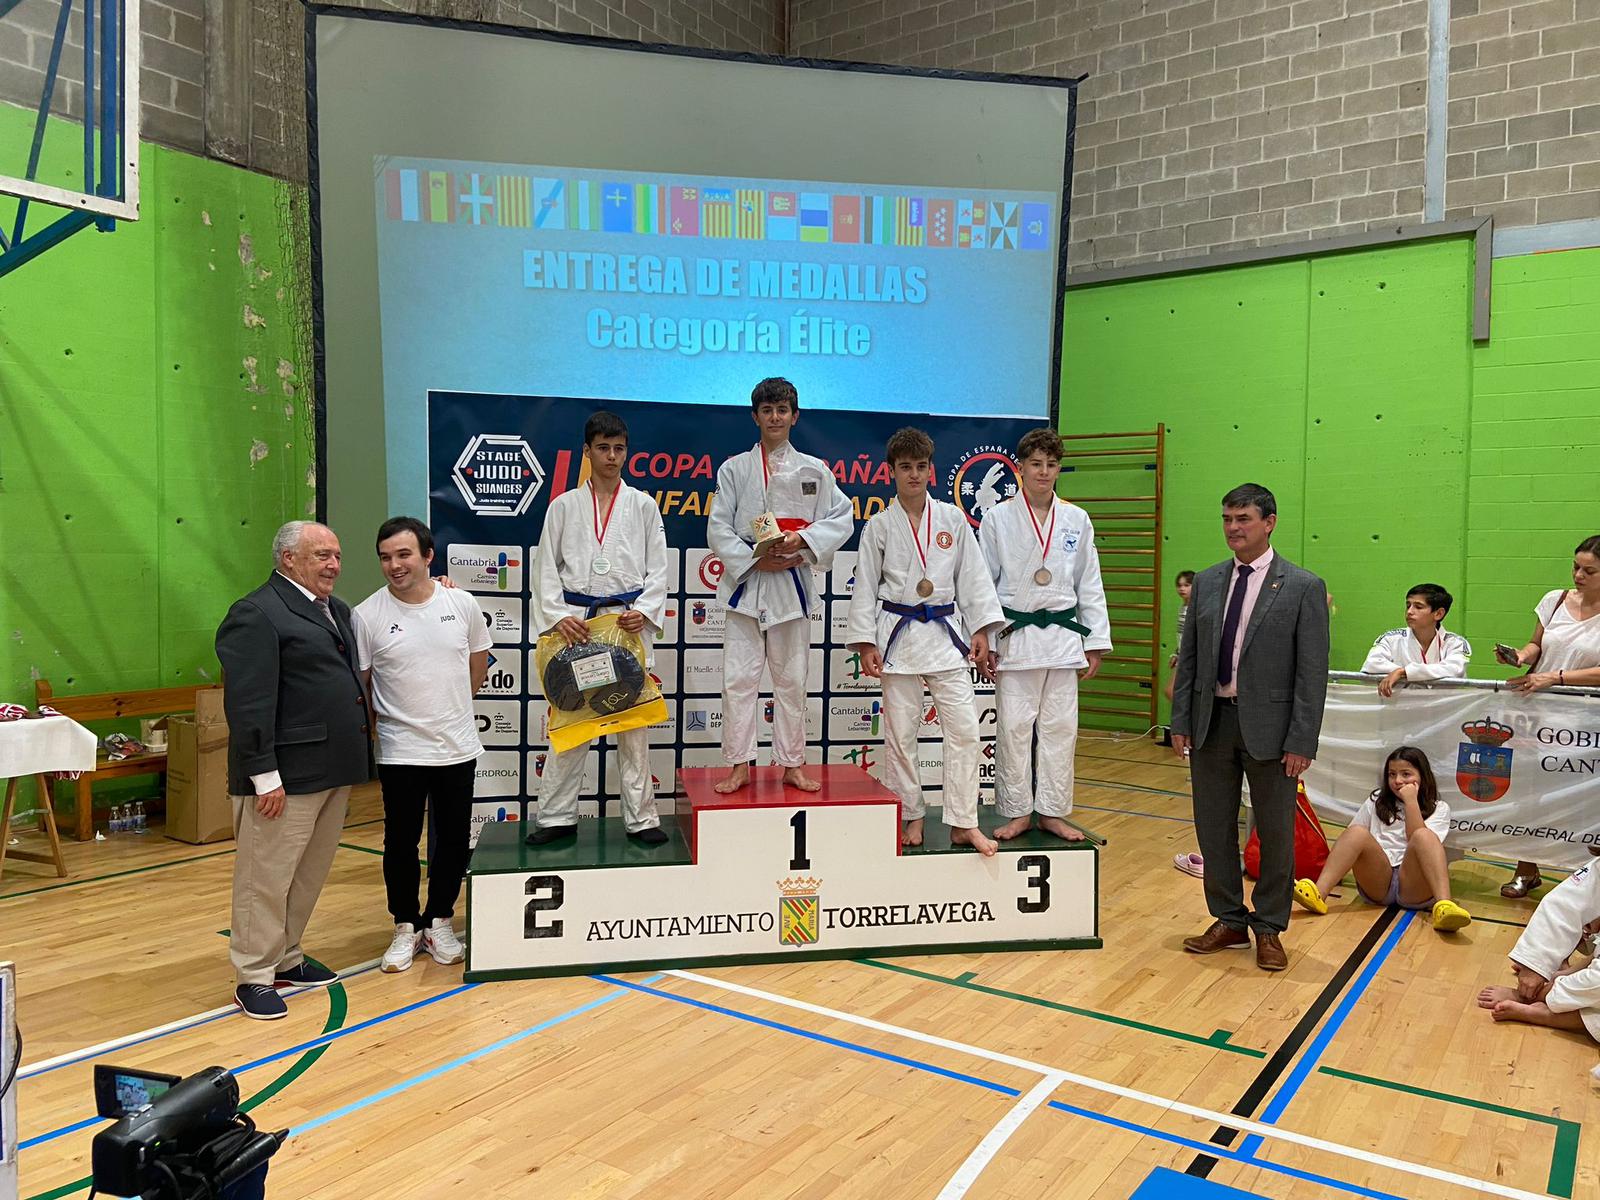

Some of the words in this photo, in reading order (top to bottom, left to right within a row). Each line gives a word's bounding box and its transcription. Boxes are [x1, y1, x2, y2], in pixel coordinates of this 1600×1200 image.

[522, 248, 688, 294] ENTREGA
[700, 256, 741, 297] DE
[749, 262, 927, 304] MEDALLAS
[586, 308, 781, 356] Categoría
[790, 310, 872, 357] Élite
[476, 450, 521, 462] STAGE
[628, 452, 713, 479] COPA
[947, 463, 960, 487] COPA
[960, 452, 971, 462] DE
[974, 445, 1007, 454] ESPAÑA
[473, 464, 522, 480] JUDO
[961, 481, 974, 496] 柔
[450, 556, 497, 567] Cantabria
[831, 705, 871, 715] Cantabria
[1536, 727, 1600, 749] GOBI
[476, 769, 519, 777] ERDROLA
[789, 810, 811, 871] 1
[1450, 819, 1498, 833] CCIÓN
[1502, 824, 1577, 843] GENERAL
[1016, 855, 1051, 914] 3
[524, 875, 564, 939] 2
[823, 901, 996, 930] TORRELAVEGA
[586, 912, 775, 942] AYUNTAMIENTO
